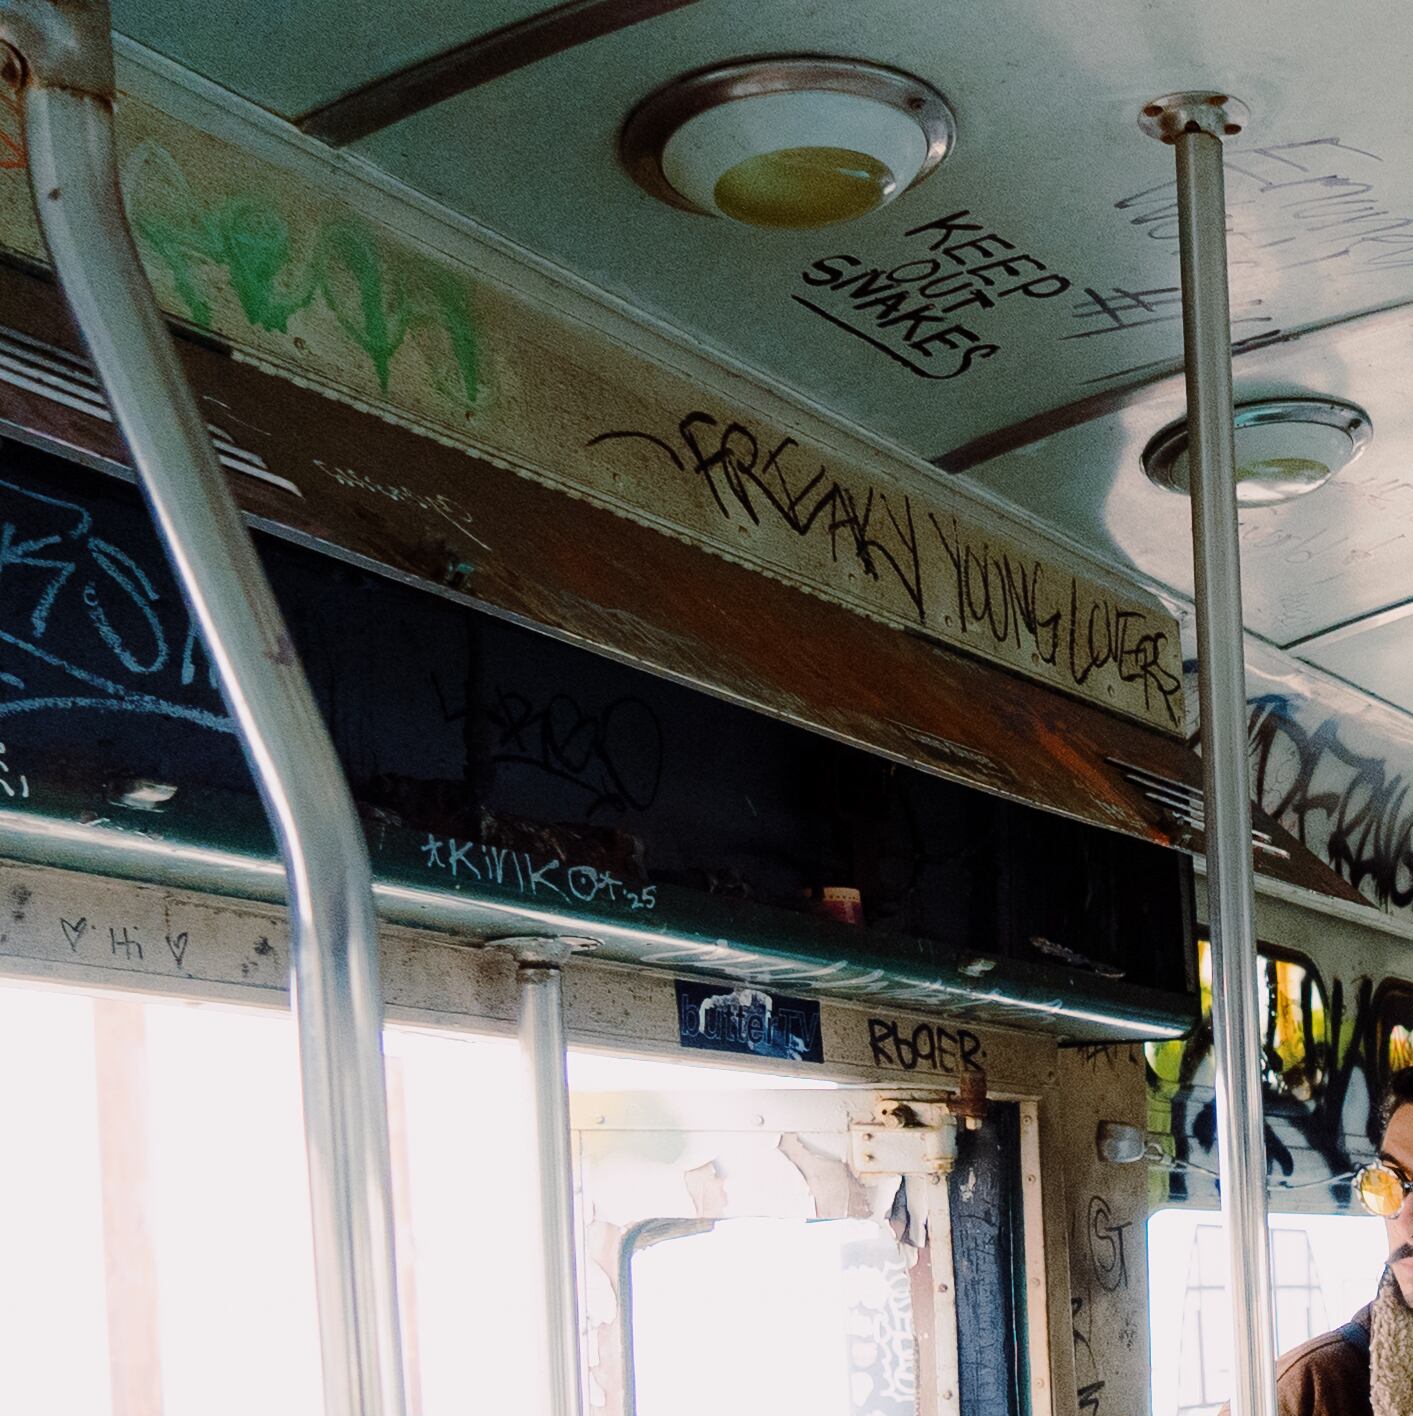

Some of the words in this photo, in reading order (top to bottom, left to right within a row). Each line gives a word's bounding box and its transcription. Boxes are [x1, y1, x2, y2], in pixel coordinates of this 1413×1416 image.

[886, 258, 996, 315] OUT
[904, 209, 1072, 299] KEEP
[801, 253, 1001, 379] SNAKES
[928, 511, 1058, 665] YOUNG
